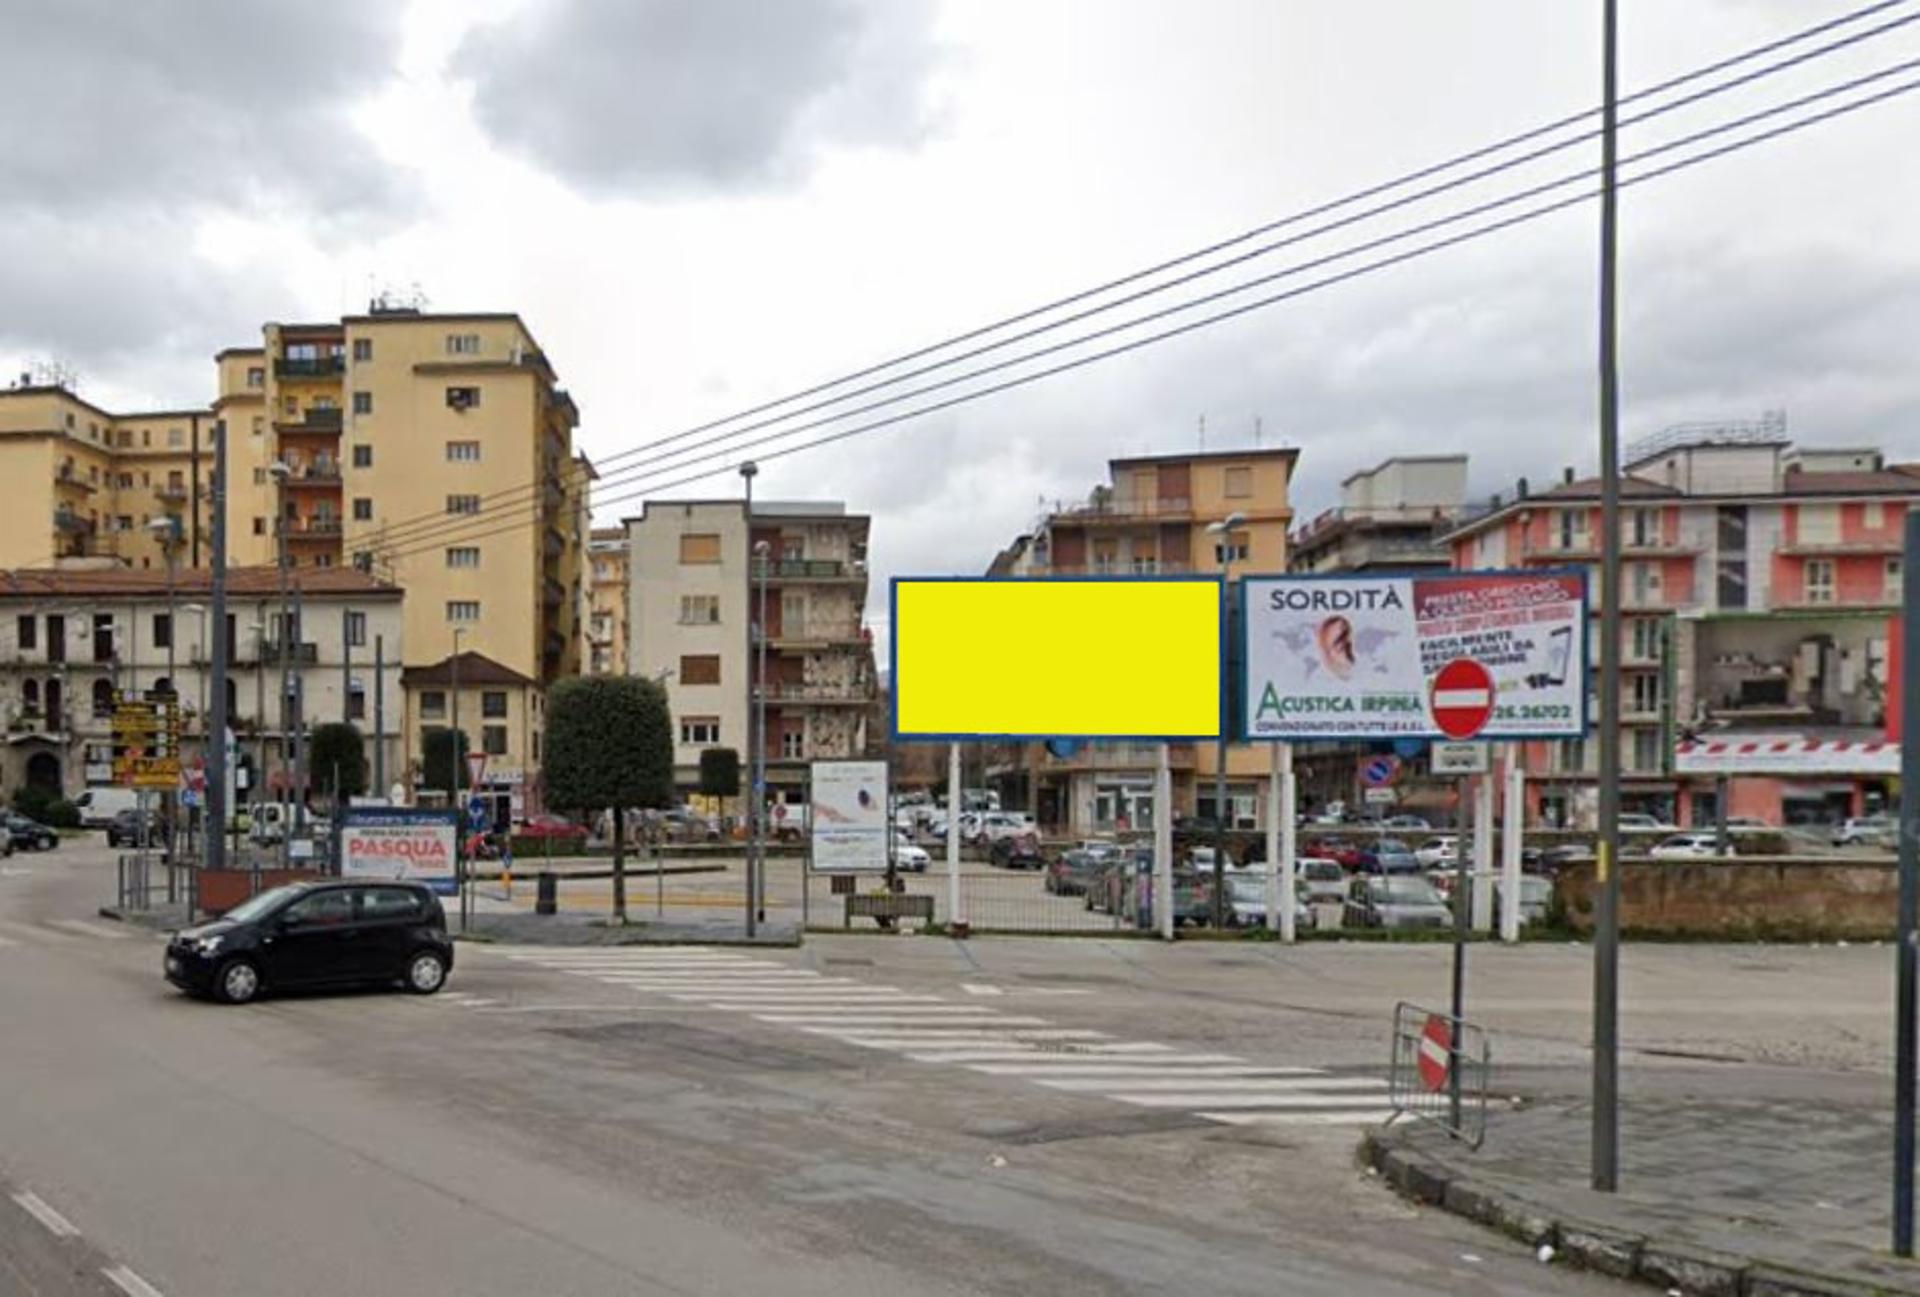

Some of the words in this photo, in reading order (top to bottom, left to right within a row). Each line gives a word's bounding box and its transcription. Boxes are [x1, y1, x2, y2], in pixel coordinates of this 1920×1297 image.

[1270, 583, 1403, 611] SORDITÀ
[1255, 681, 1356, 719] ACUSTICA
[348, 838, 446, 863] PASQUA
